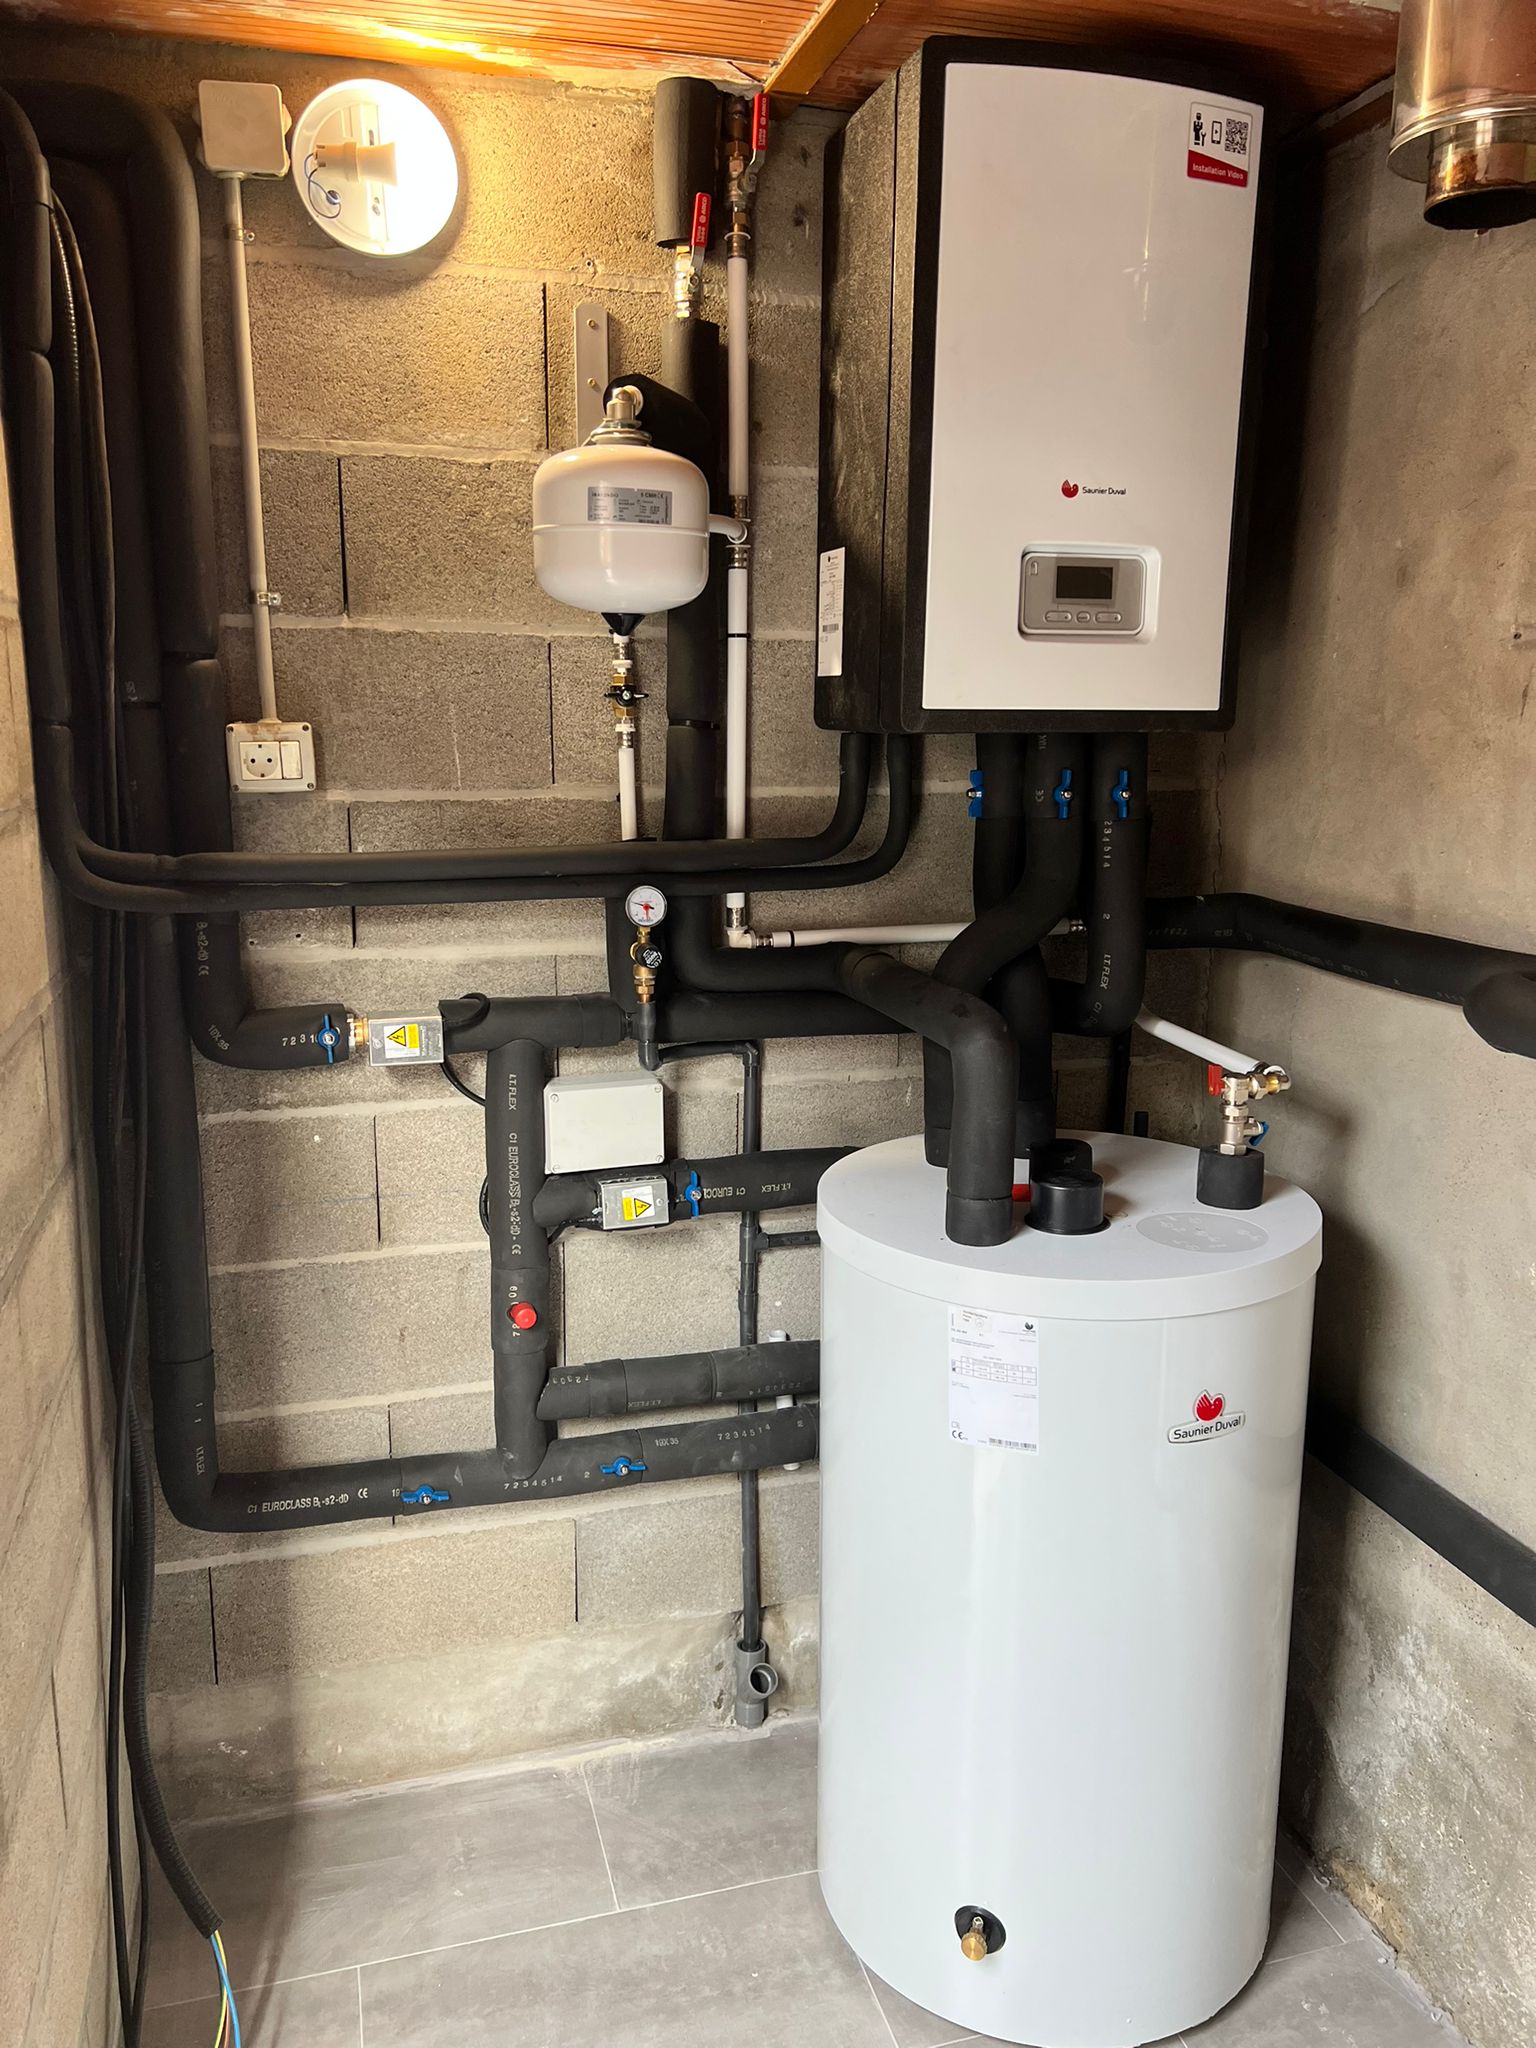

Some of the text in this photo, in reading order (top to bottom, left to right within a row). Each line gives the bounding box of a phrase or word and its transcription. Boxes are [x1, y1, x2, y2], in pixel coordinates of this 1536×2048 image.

[1192, 163, 1244, 180] Installation Video
[1082, 486, 1127, 496] Saunier Duval
[508, 1146, 521, 1199] EUROCLASS
[1173, 1415, 1241, 1440] Saunier Duval
[247, 1504, 258, 1514] C1
[261, 1497, 312, 1513] EUROCLASS
